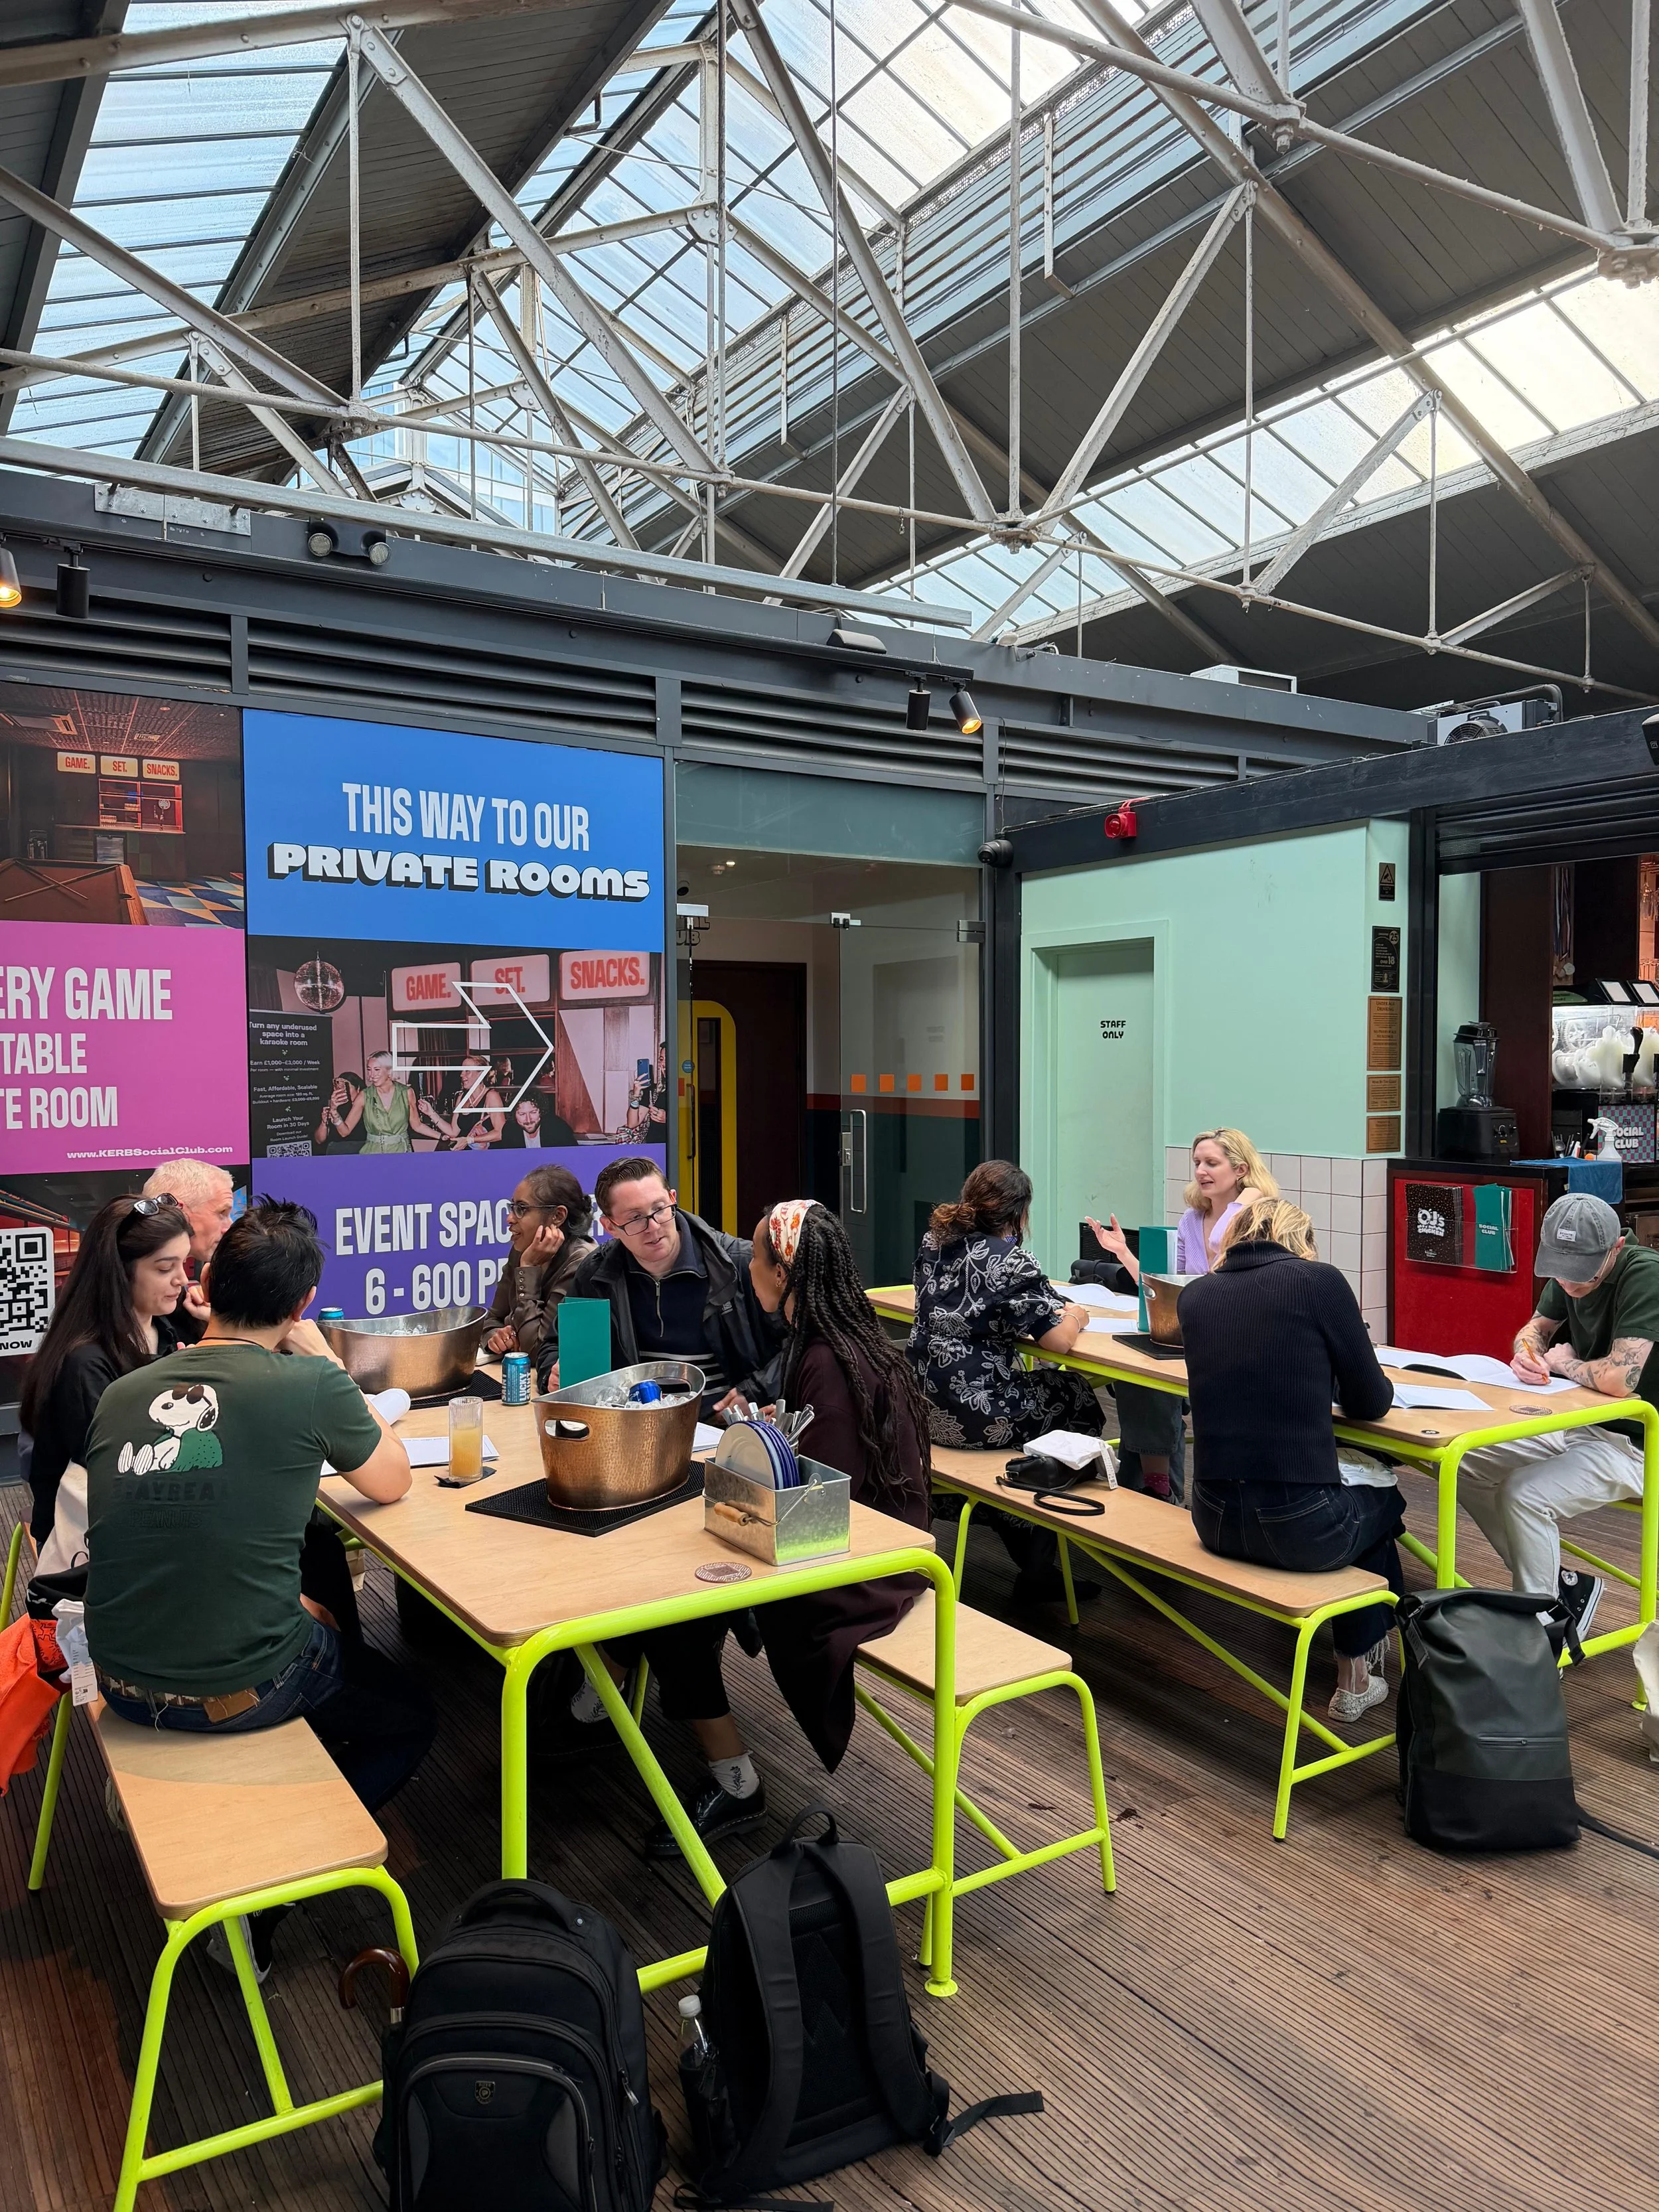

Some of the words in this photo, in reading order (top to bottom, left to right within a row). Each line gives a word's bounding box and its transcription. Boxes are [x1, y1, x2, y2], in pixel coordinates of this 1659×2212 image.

[65, 757, 90, 769] GAME.
[112, 761, 127, 772] SET.
[147, 763, 178, 776] SNACKS.
[342, 782, 413, 836] THIS
[419, 790, 485, 843] WAY
[492, 798, 528, 846] TO
[534, 802, 589, 852] OUR
[268, 842, 479, 891] PRIVATE
[484, 859, 651, 902] ROOMS
[1390, 932, 1398, 942] 25
[570, 957, 646, 990] SNACKS.
[1388, 956, 1395, 965] 18
[0, 966, 55, 1019] RY
[65, 967, 173, 1020] GAME
[405, 972, 451, 1001] GAME.
[494, 966, 526, 995] SET.
[0, 1033, 88, 1074] TABLE
[0, 1088, 23, 1130] E
[30, 1086, 118, 1129] ROOM
[66, 1146, 234, 1159] www.KERBSocialClub.com
[1614, 1138, 1639, 1149] CLUB
[335, 1202, 433, 1256] EVENT
[439, 1198, 513, 1250] SPAC
[365, 1267, 386, 1315] 6
[411, 1261, 472, 1309] 600
[0, 1340, 33, 1351] NOW
